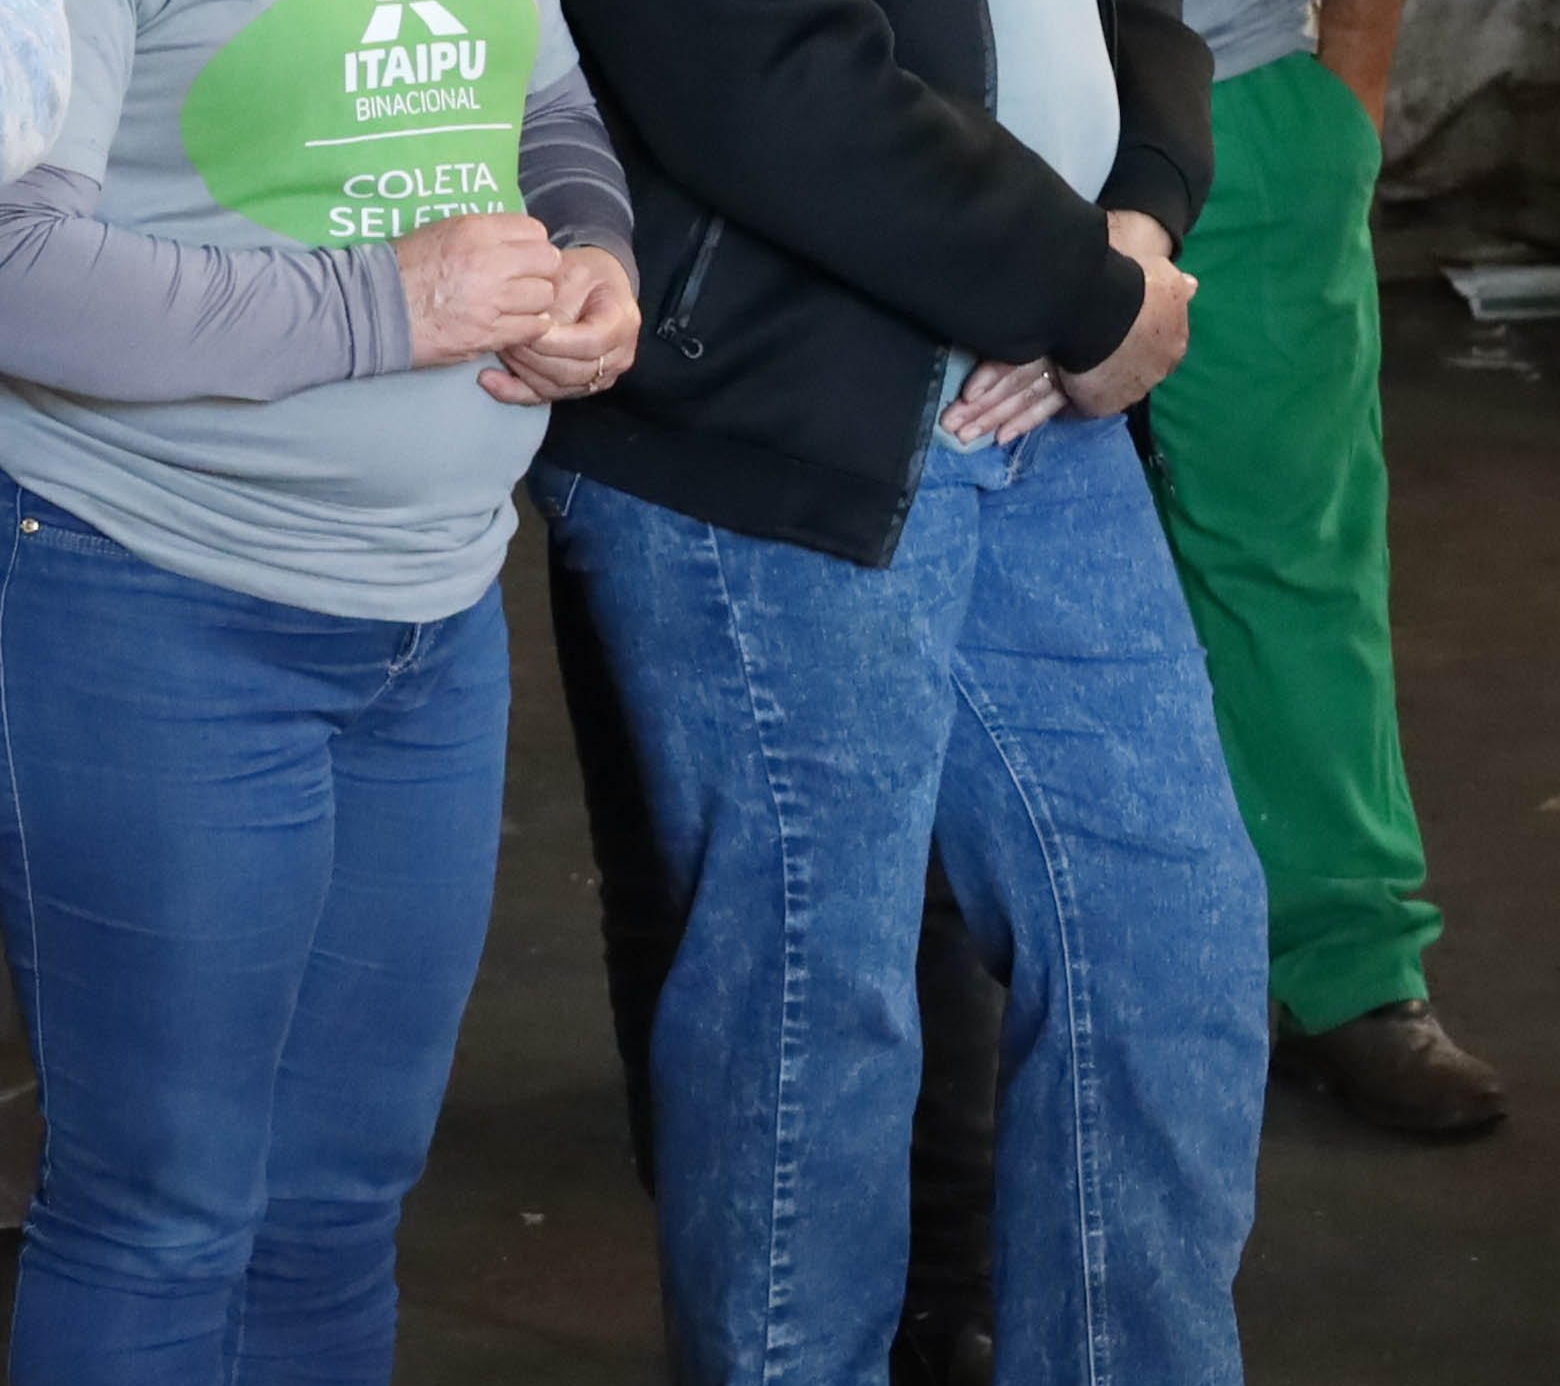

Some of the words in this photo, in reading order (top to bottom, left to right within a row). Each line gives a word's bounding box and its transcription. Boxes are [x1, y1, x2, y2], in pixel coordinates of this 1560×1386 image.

[344, 40, 486, 93] ITAIPU
[355, 87, 482, 122] BINACIONAL
[343, 162, 499, 199] COLETA
